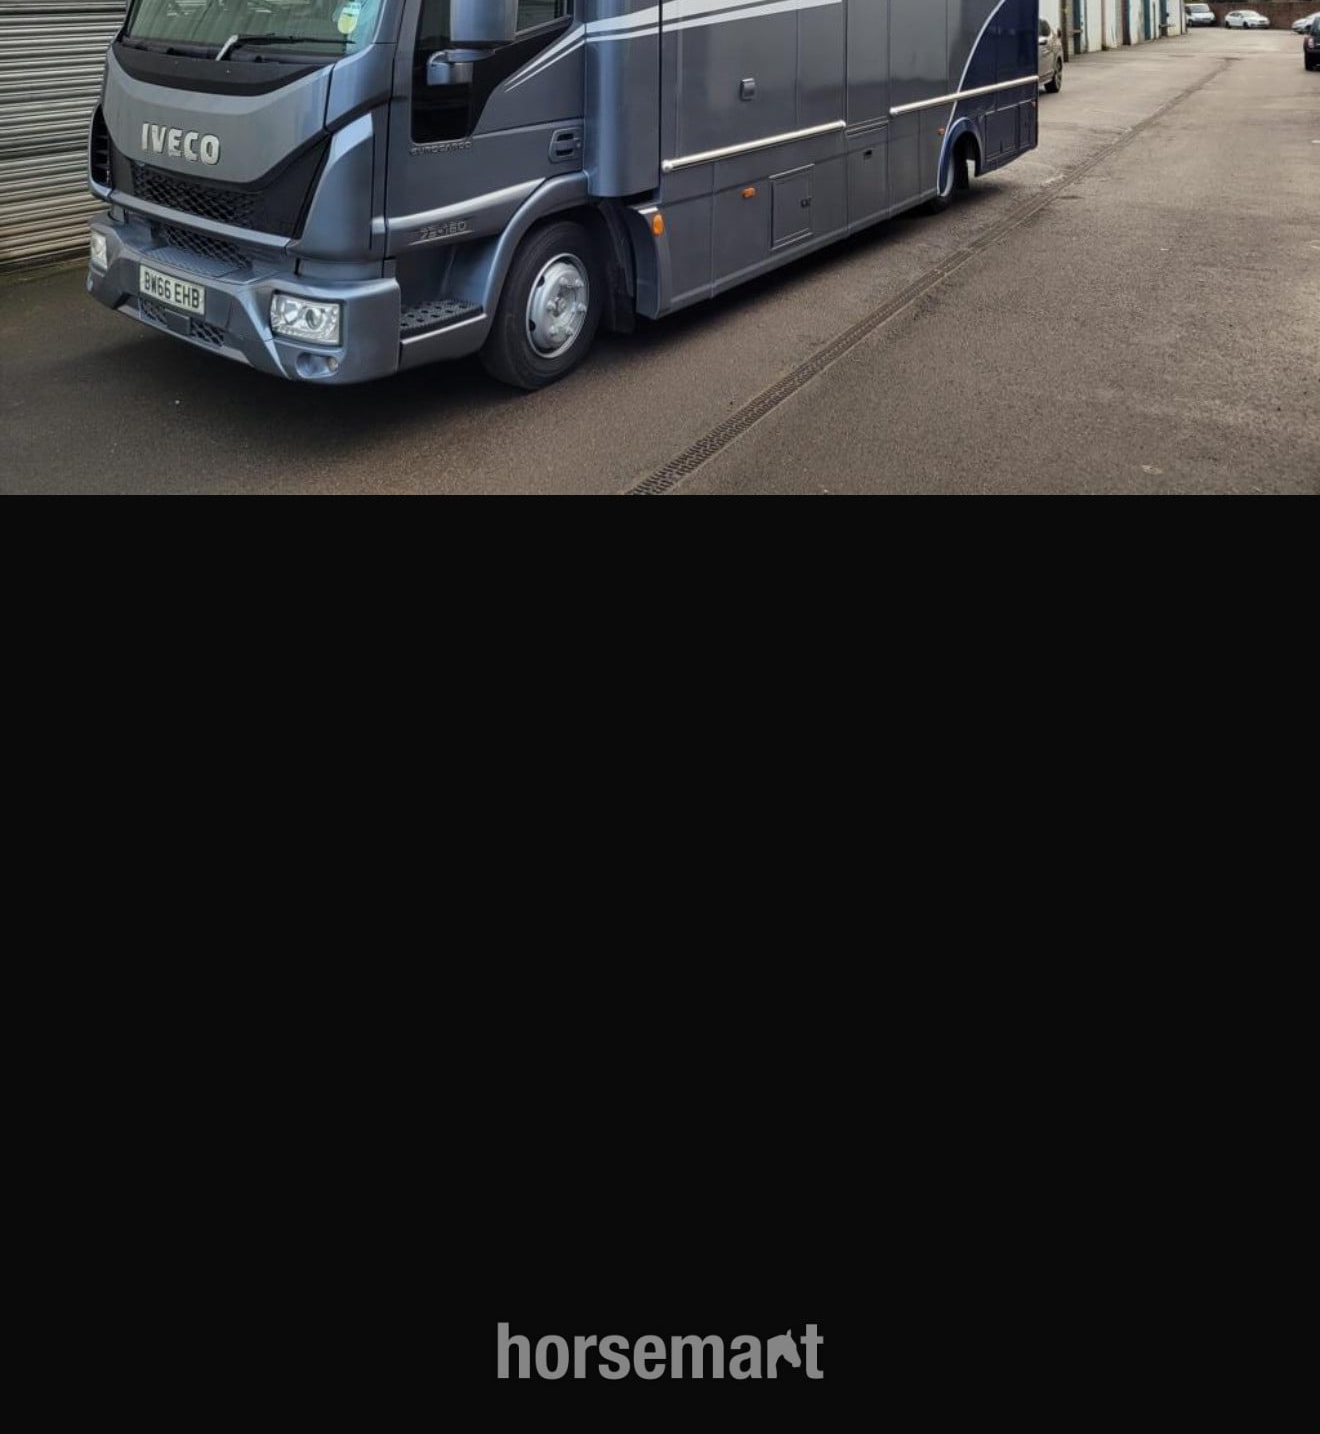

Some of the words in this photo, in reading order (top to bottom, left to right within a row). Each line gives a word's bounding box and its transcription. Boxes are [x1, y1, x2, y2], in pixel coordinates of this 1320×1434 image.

[141, 122, 220, 165] IVECO
[144, 270, 172, 300] BW66
[174, 282, 200, 309] EHB
